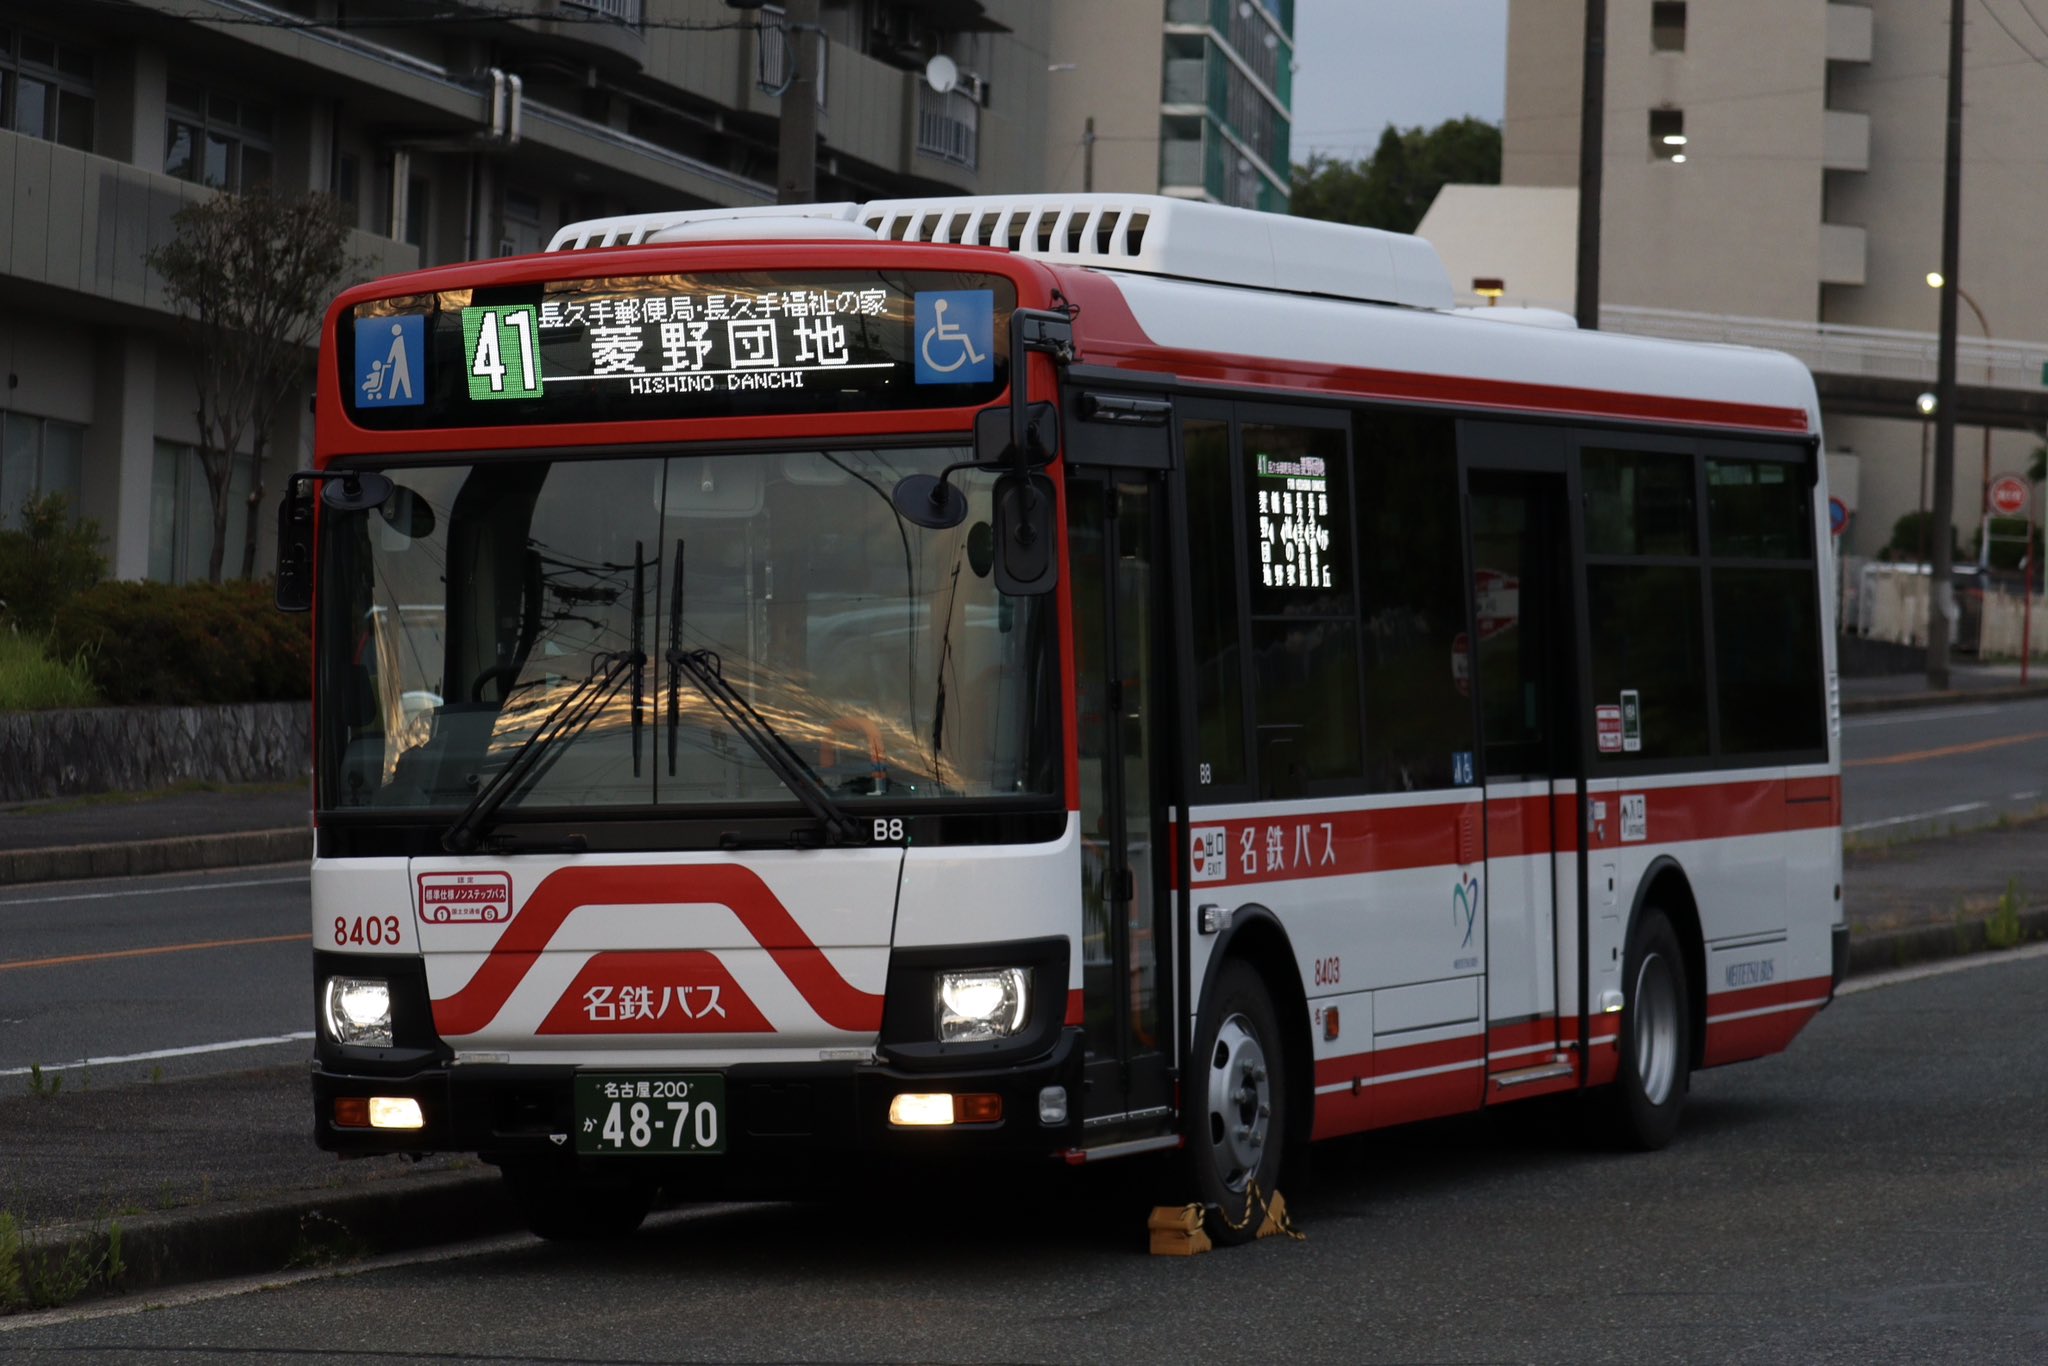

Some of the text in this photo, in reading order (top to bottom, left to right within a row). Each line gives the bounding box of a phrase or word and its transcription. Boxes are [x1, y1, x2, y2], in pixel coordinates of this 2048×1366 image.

[473, 310, 535, 391] 41
[590, 316, 849, 375] 菱野団地
[630, 371, 804, 394] HISHINO DANCHI
[874, 818, 904, 841] B8
[1205, 832, 1224, 858] 出口
[1240, 822, 1336, 875] 名鉄バス
[1208, 861, 1222, 876] EXIT
[425, 888, 506, 901] 標準仕様ノンステップバス
[334, 915, 401, 946] 8403
[1315, 956, 1340, 987] 8403
[583, 985, 726, 1021] 名鉄バス
[583, 1101, 718, 1148] か 48-70
